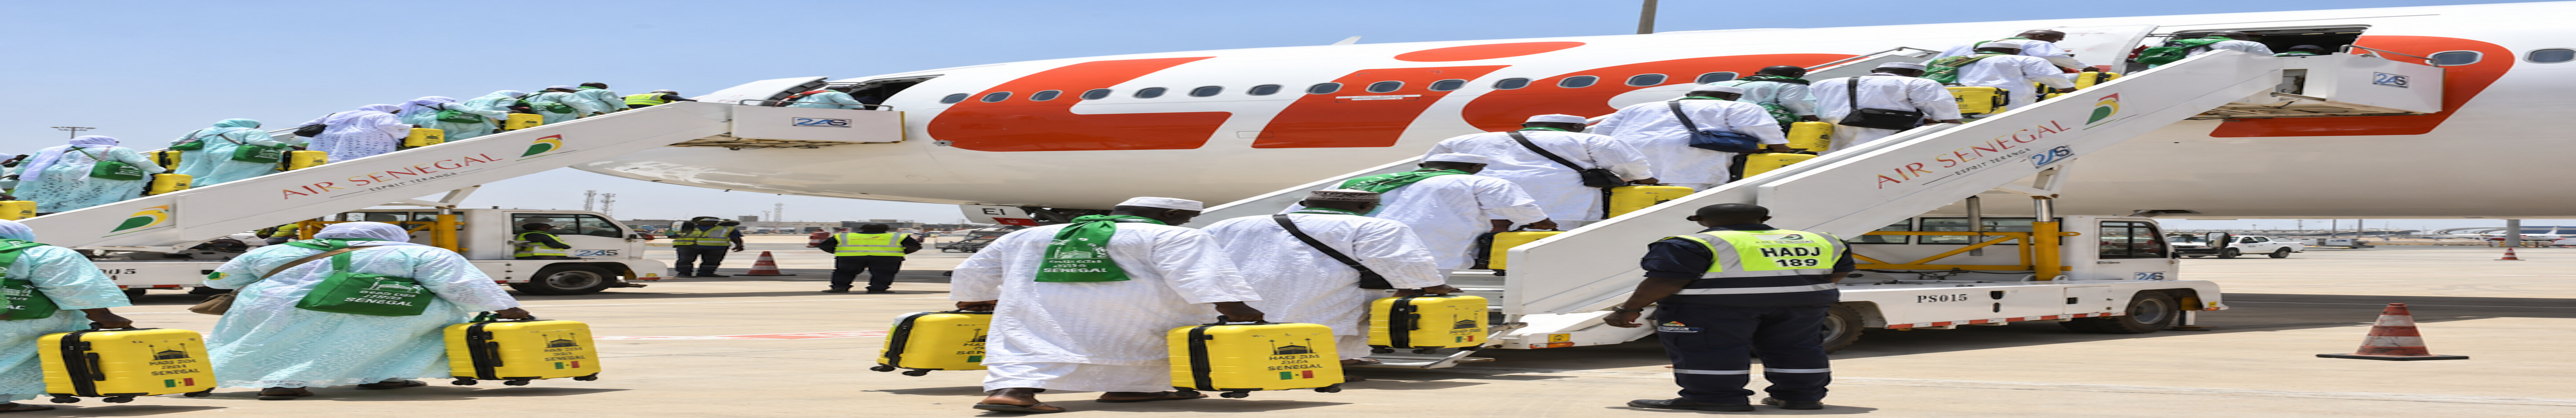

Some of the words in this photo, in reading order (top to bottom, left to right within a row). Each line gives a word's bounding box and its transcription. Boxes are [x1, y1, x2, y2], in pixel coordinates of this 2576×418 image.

[1876, 161, 1933, 189] AIR
[1936, 120, 2071, 168] SENEGAL
[282, 181, 344, 199] AIR
[346, 153, 503, 186] SENEGAL
[1760, 247, 1820, 257] HADJ
[1775, 258, 1818, 267] 189
[344, 297, 413, 306] SENEGAL
[1916, 294, 1968, 303] PS015
